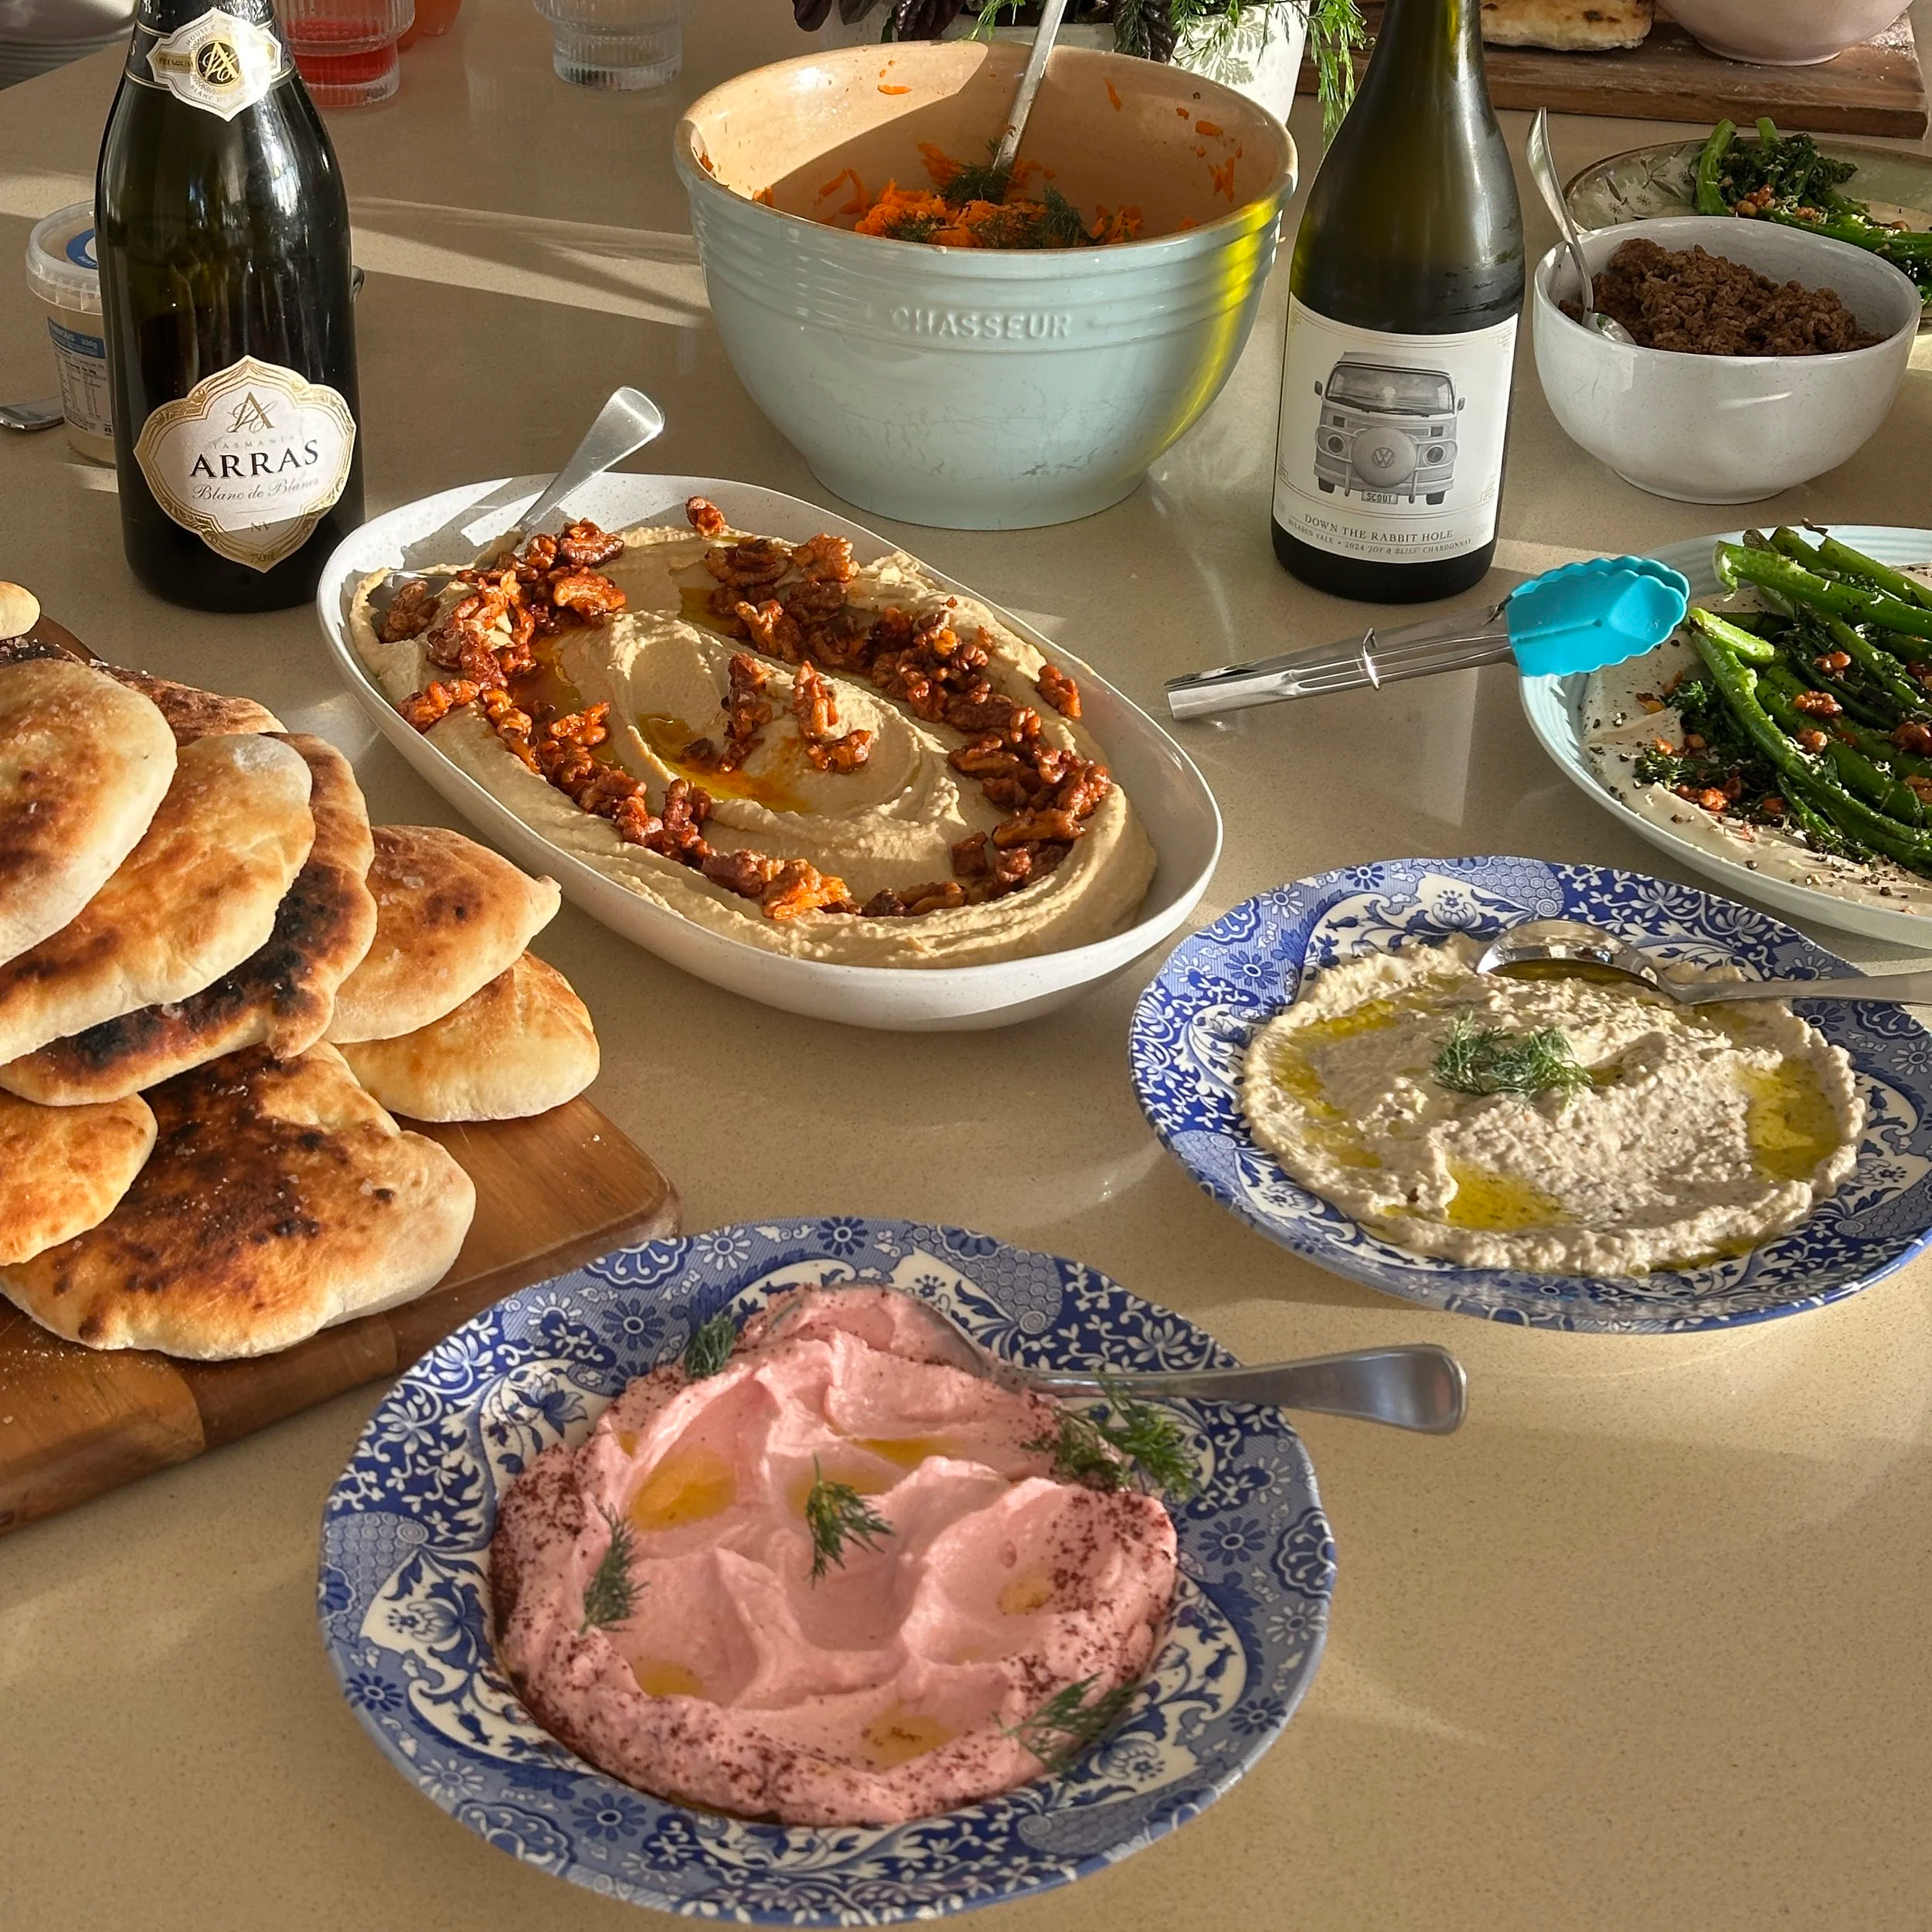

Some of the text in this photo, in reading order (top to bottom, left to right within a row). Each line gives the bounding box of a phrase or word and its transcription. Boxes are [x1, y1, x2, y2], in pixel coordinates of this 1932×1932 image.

[892, 307, 1071, 338] CHASSEUR
[213, 435, 295, 450] TASMANIA
[189, 439, 319, 478] ARRAS
[192, 484, 244, 501] Blanc
[247, 485, 265, 500] de
[1366, 492, 1393, 503] SCOUT
[1304, 513, 1454, 543] DOWN THE RABBIT HOLE
[1316, 533, 1334, 545] VALE
[1345, 541, 1365, 552] 2024
[1422, 538, 1471, 554] CHARDONNAY
